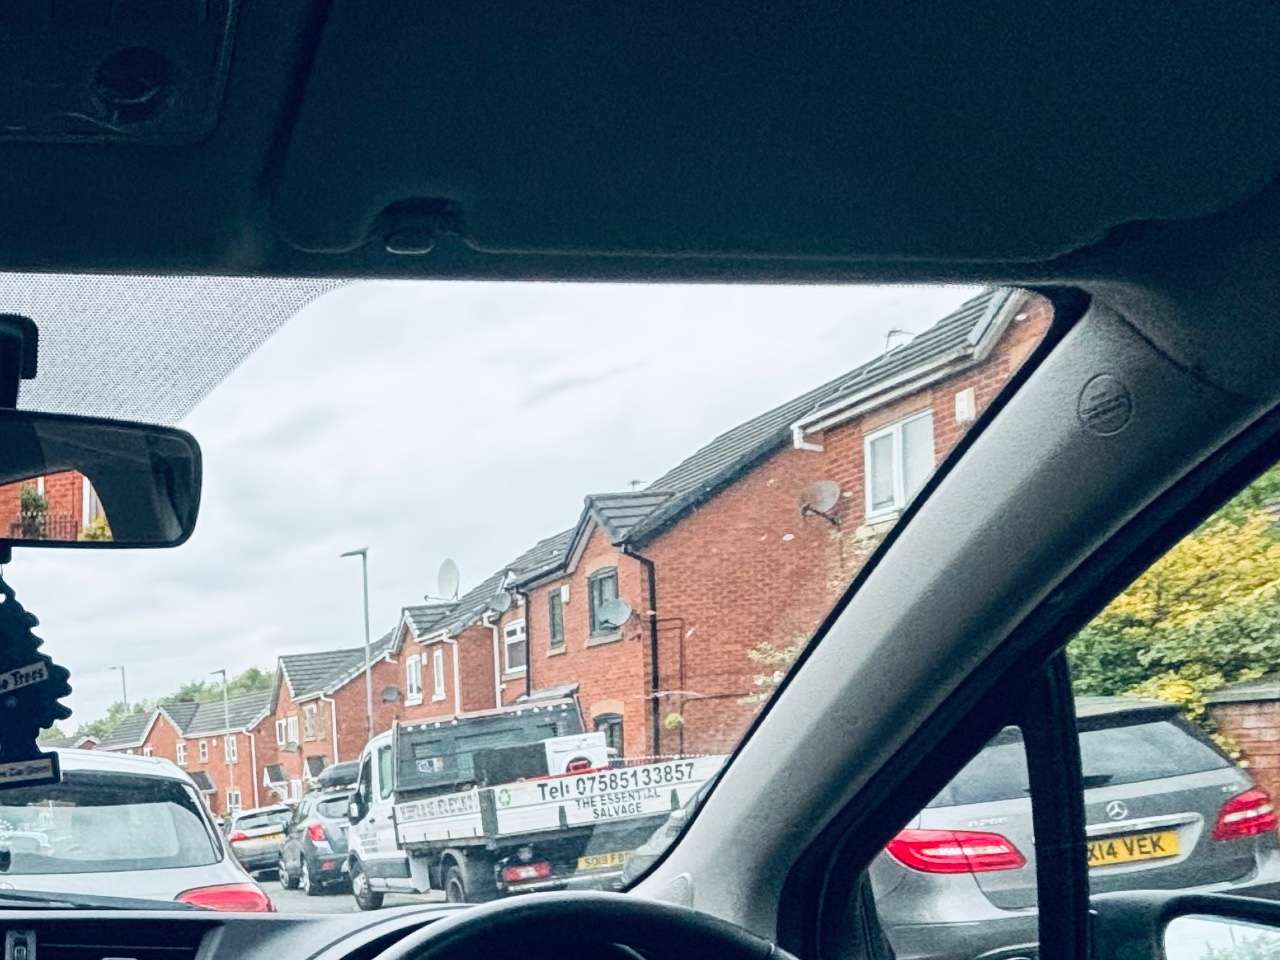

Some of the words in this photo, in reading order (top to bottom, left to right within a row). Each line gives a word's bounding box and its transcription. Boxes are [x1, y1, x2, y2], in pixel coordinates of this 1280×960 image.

[576, 763, 695, 796] 07585133857
[575, 798, 597, 810] THE
[600, 788, 661, 806] ESSENTIAL
[593, 802, 643, 819] SALVAGE
[1122, 835, 1166, 856] VEK
